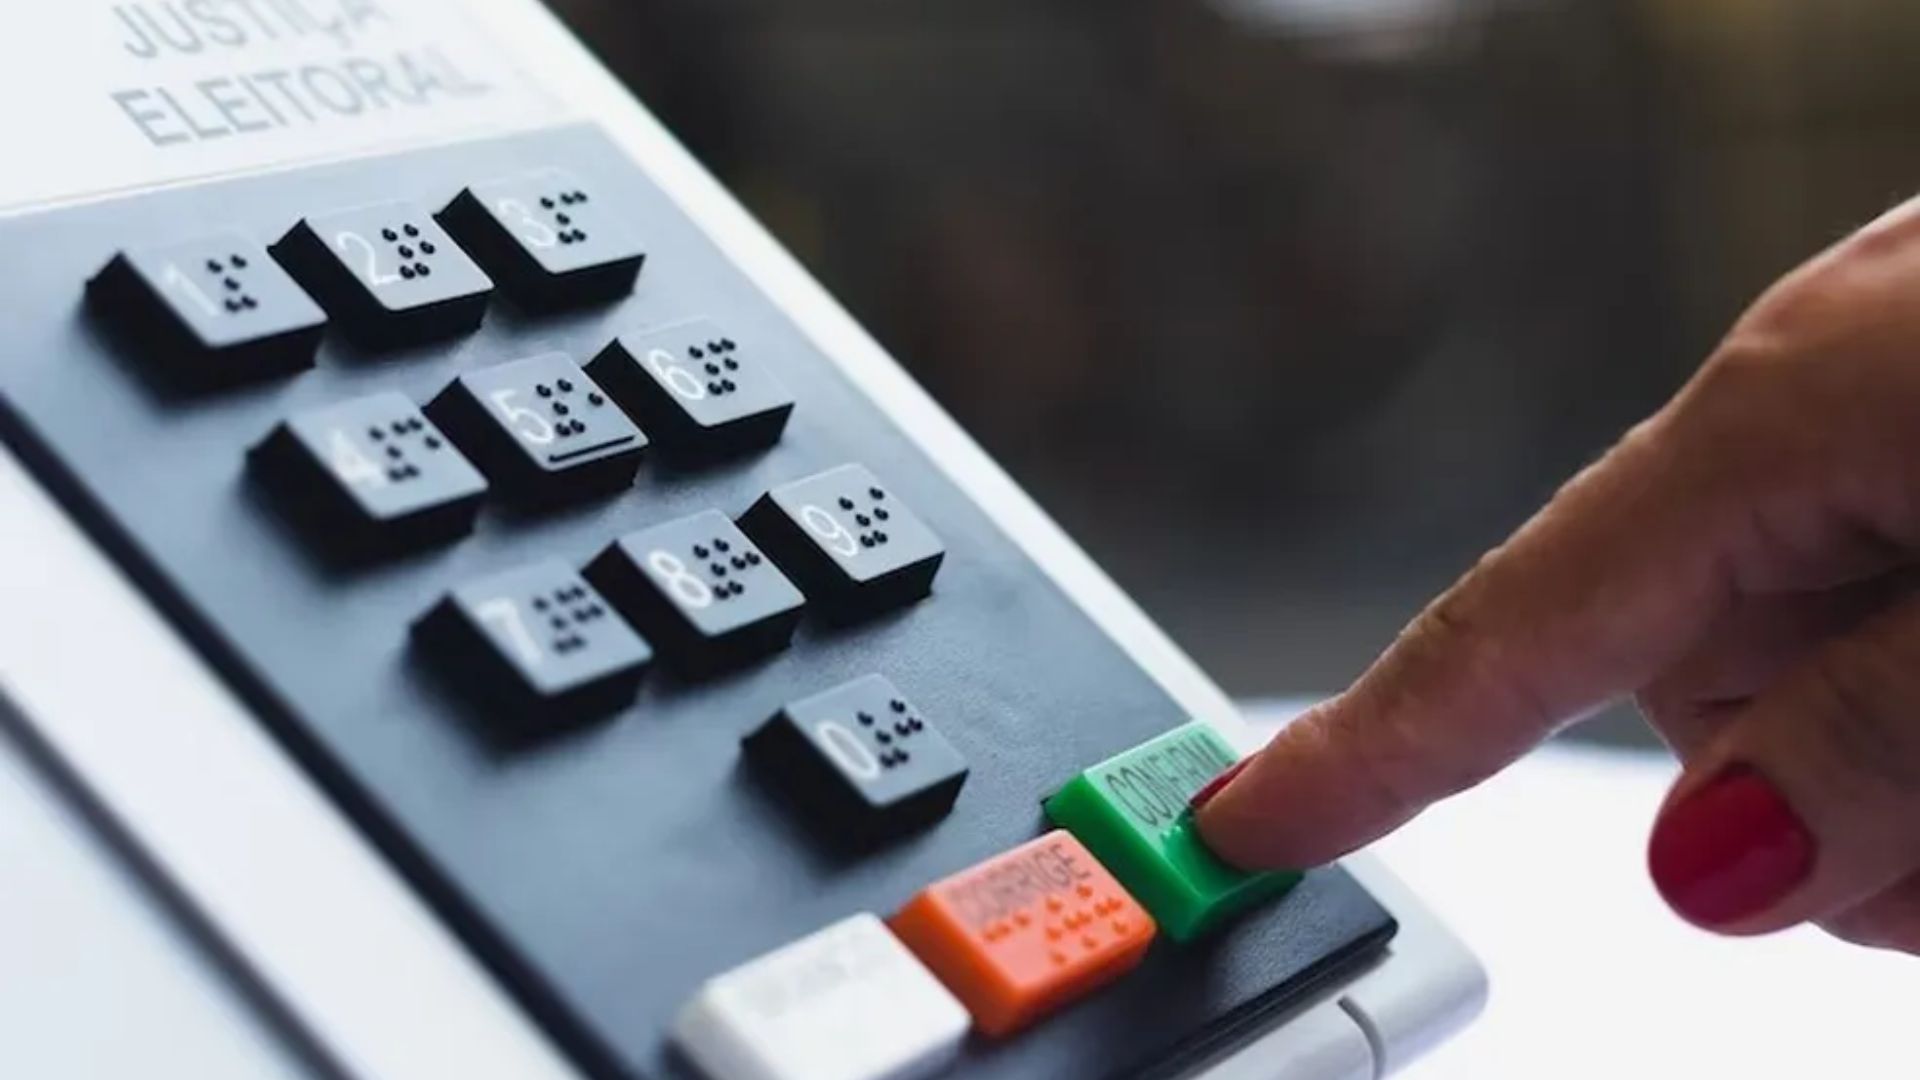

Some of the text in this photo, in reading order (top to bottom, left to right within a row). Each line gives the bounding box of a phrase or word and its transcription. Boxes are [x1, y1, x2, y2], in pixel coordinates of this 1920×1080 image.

[109, 43, 496, 147] ELEITORAL
[499, 199, 559, 249] 3
[335, 231, 403, 287] 2
[648, 348, 703, 400] 6
[492, 389, 554, 444] 5
[802, 505, 858, 557] 9
[648, 550, 712, 608] 8
[478, 599, 542, 660] 7
